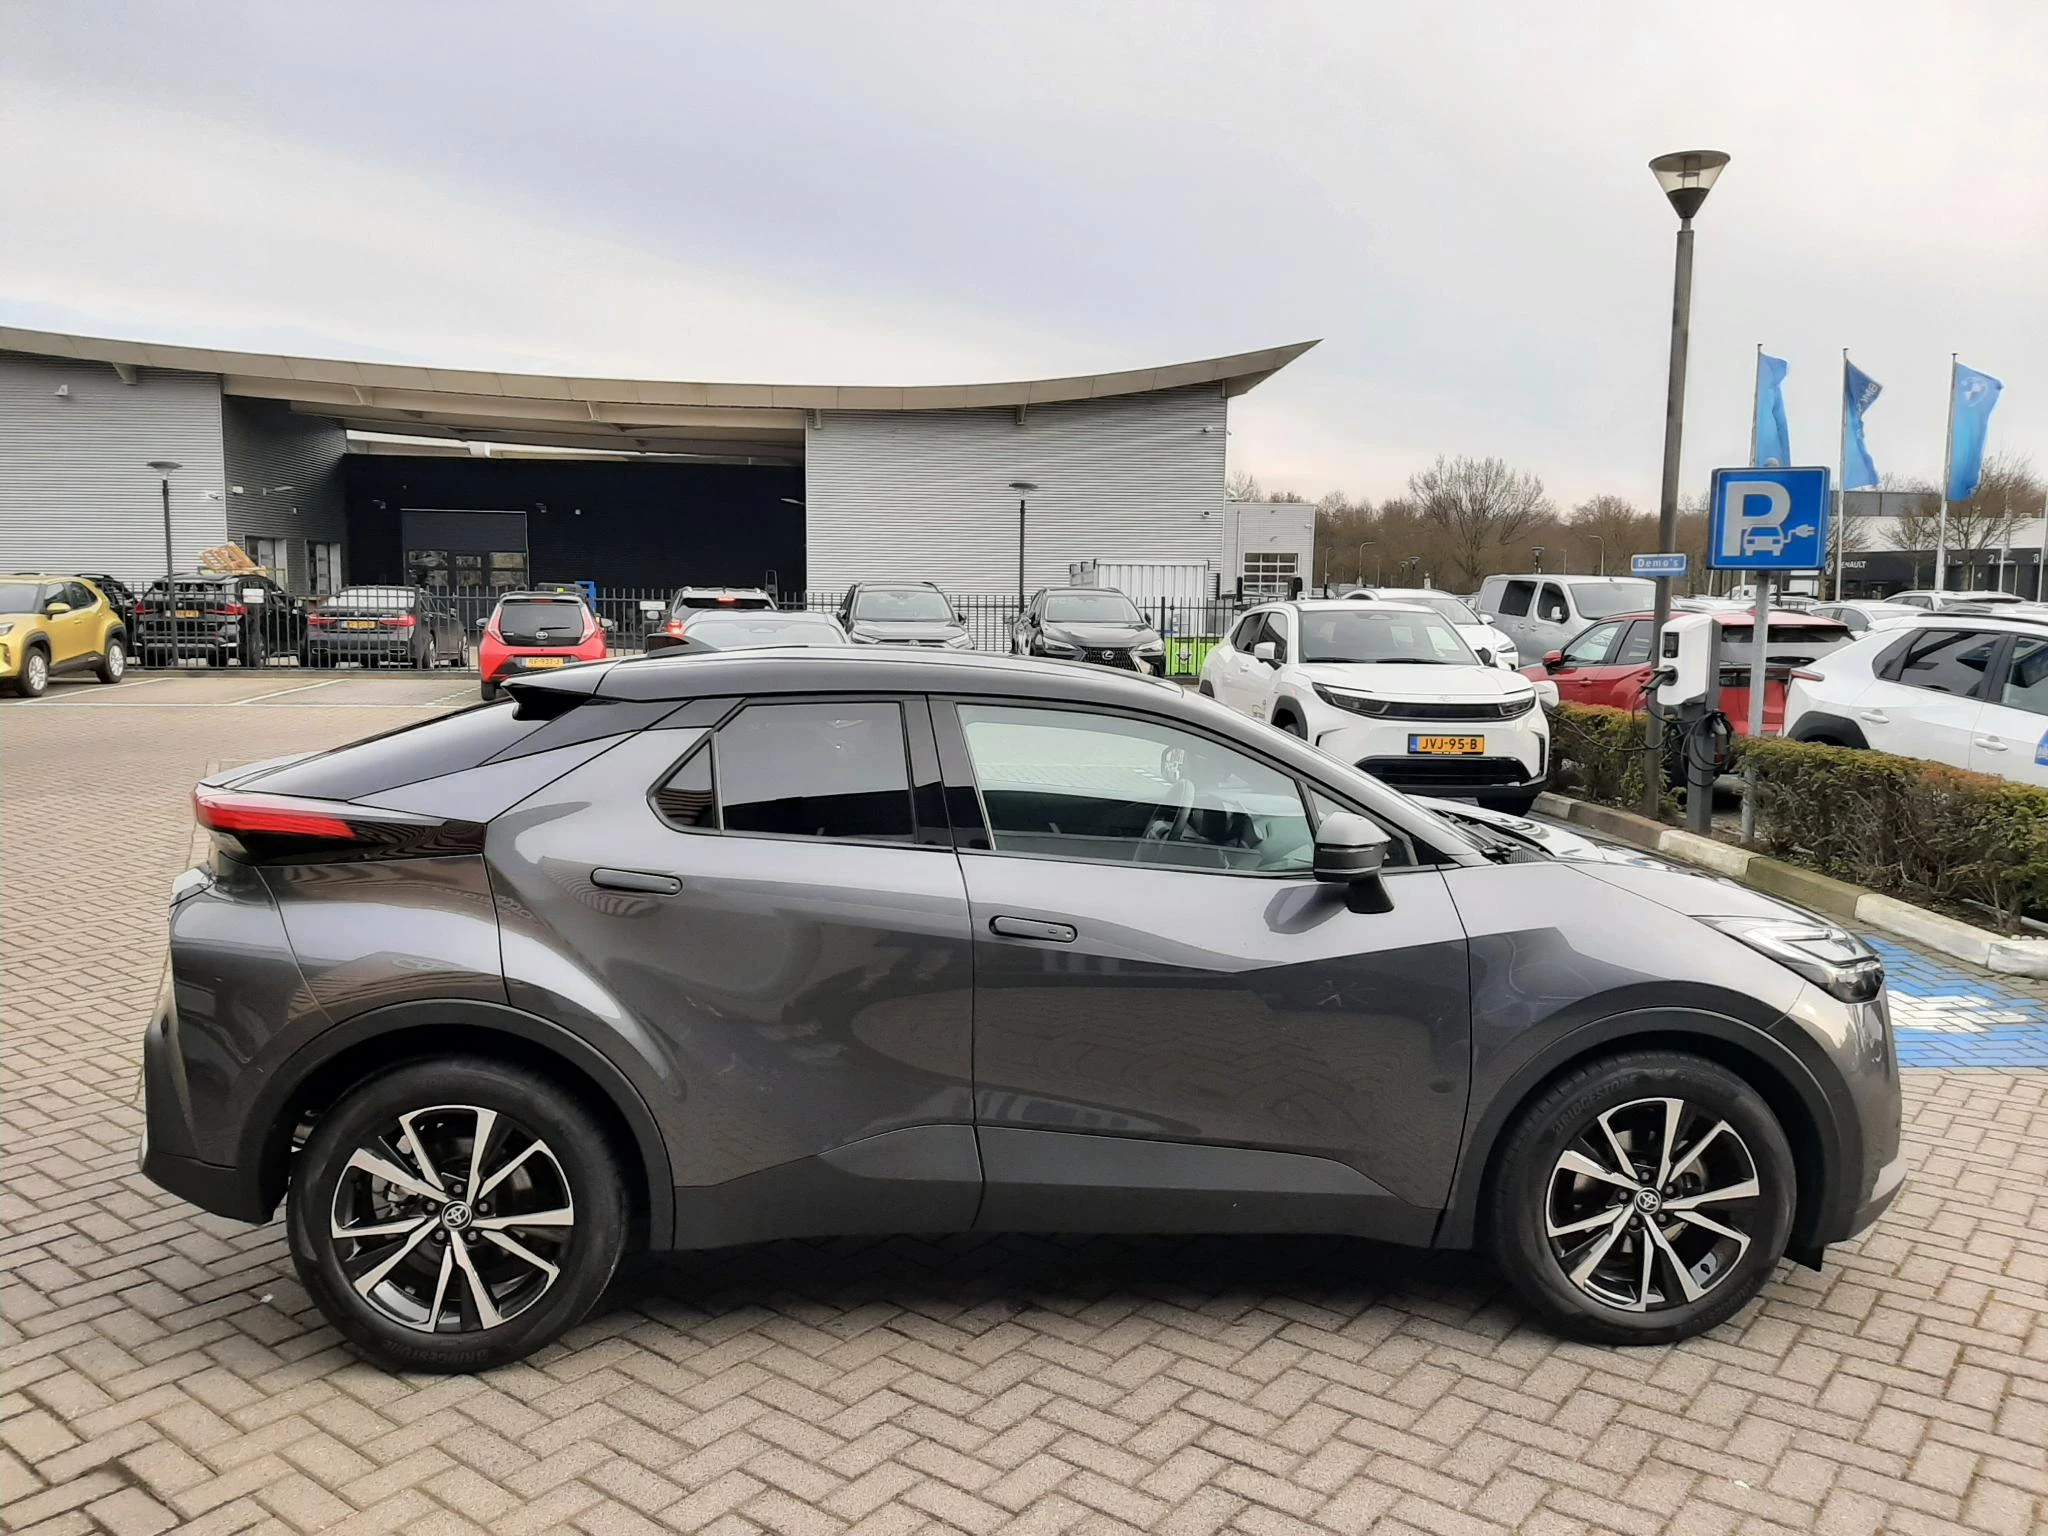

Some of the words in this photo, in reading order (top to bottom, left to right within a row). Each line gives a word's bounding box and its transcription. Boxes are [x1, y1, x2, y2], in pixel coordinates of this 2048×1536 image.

[1722, 481, 1791, 556] P
[1637, 558, 1679, 568] Demo's
[1840, 560, 1867, 569] ENAULT
[1422, 738, 1478, 750] JVJ-95-B
